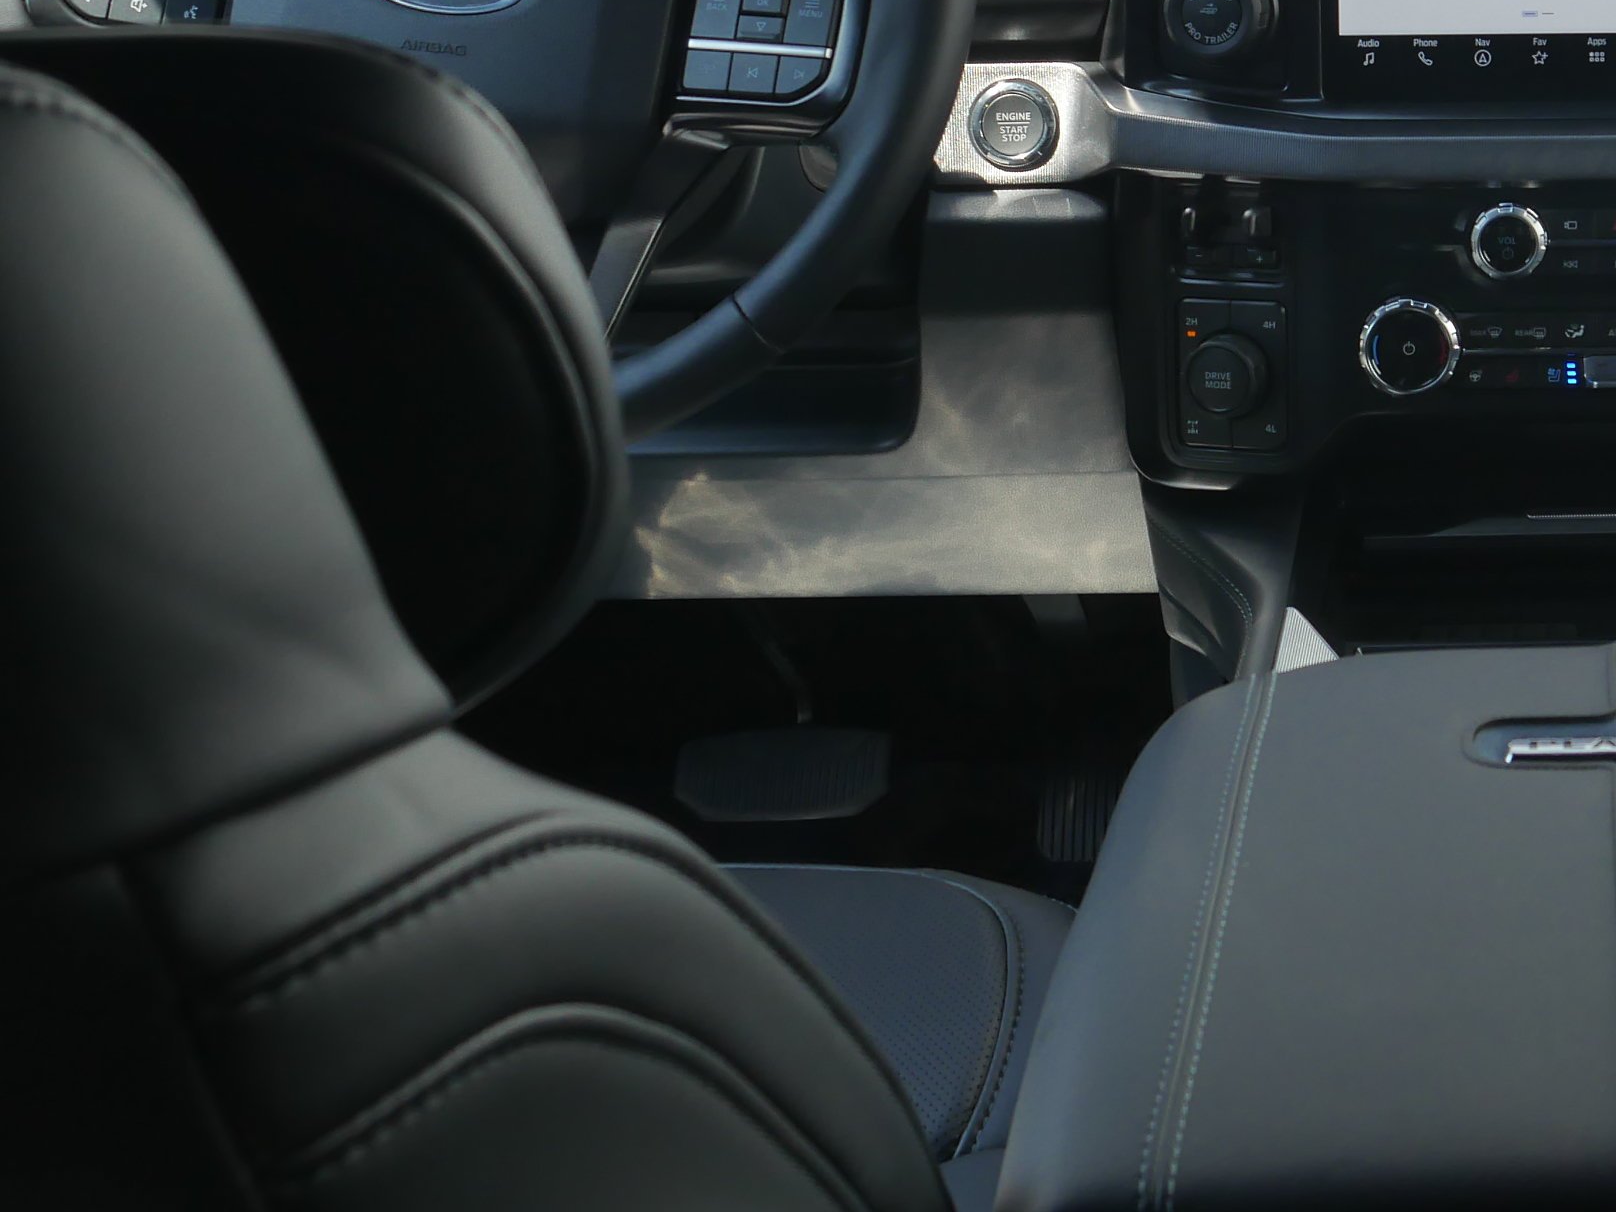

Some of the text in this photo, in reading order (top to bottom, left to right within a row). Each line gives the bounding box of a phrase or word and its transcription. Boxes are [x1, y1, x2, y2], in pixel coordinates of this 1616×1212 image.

[799, 9, 823, 18] MENU
[1184, 22, 1238, 45] PRO TRAILER
[1357, 38, 1380, 48] Audio
[1413, 38, 1438, 47] Phone
[1475, 38, 1490, 46] Nav
[1533, 37, 1547, 46] Fav
[1587, 37, 1607, 47] Apps
[401, 38, 468, 57] AIRBAG
[995, 112, 1031, 121] ENGINE
[999, 125, 1028, 134] START
[1002, 133, 1027, 142] STOP
[1185, 317, 1198, 326] 2H
[1262, 320, 1276, 329] 4H
[1204, 371, 1231, 381] DRIVE
[1205, 380, 1232, 389] MODE
[1264, 424, 1277, 433] 4L
